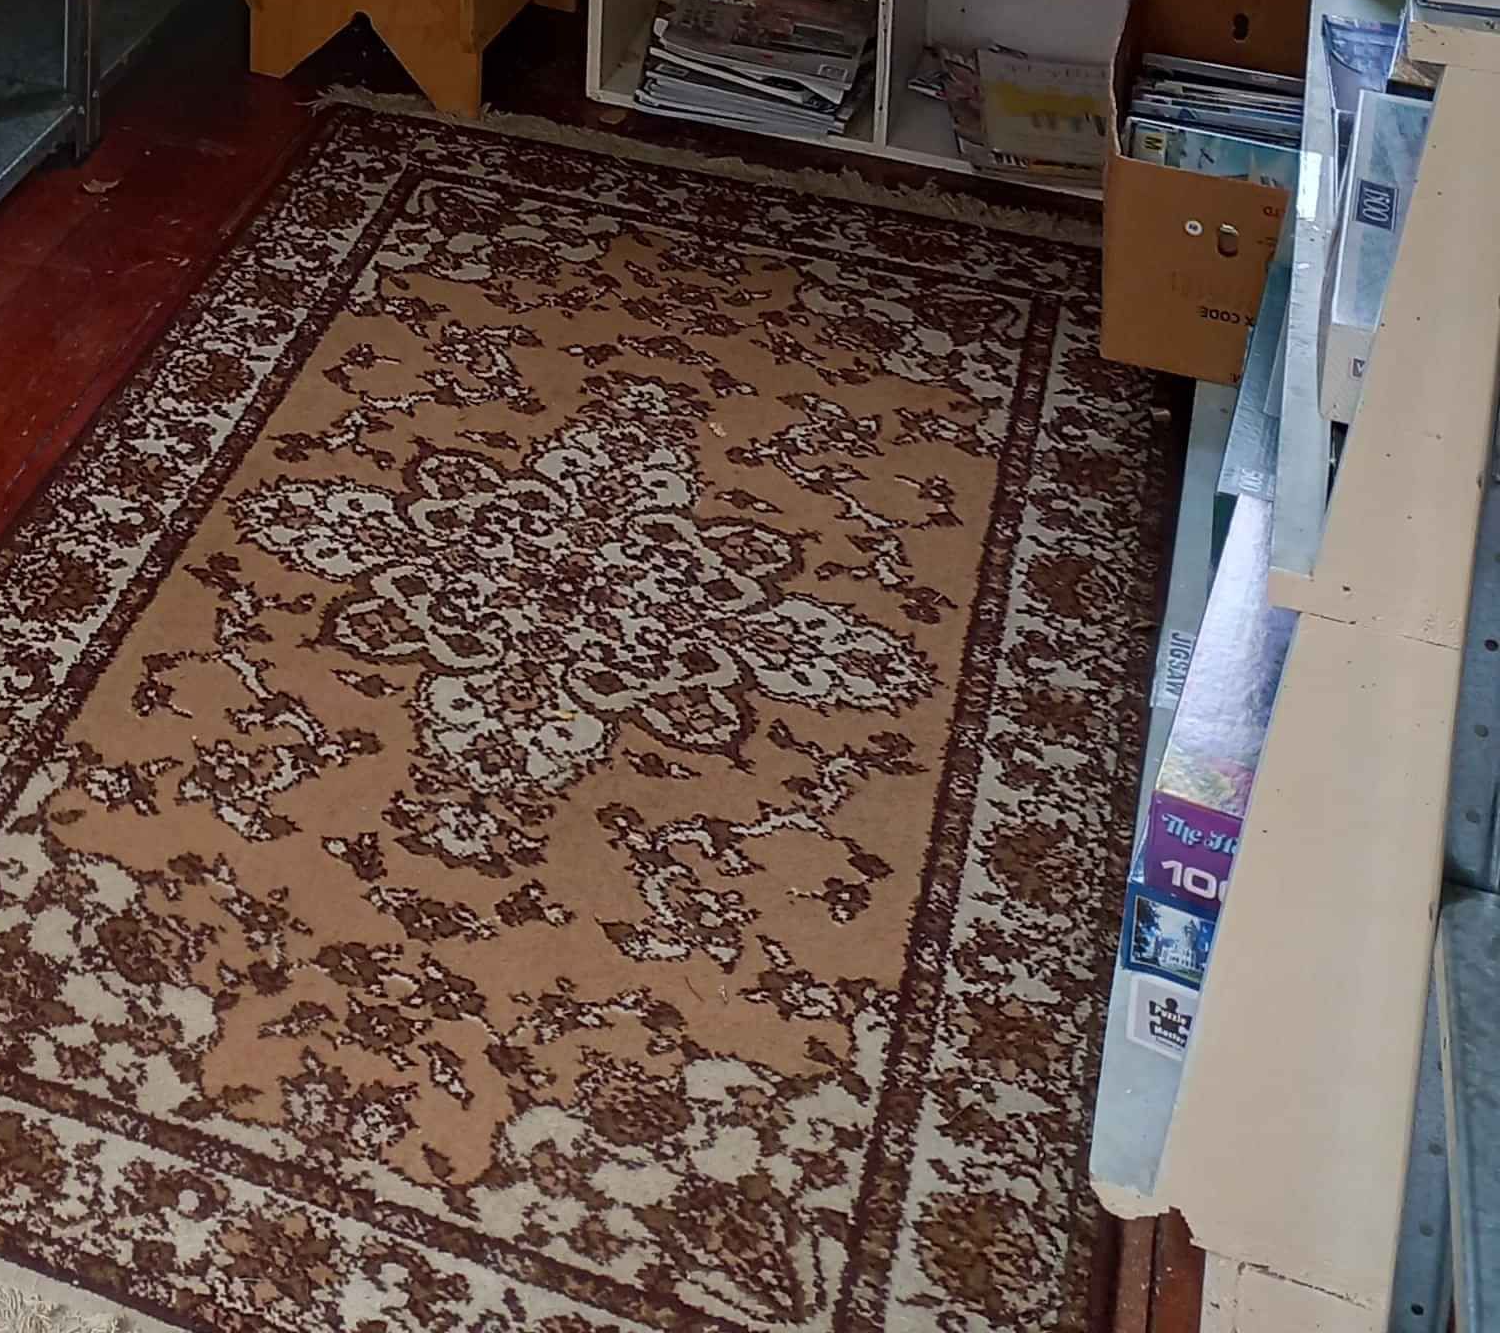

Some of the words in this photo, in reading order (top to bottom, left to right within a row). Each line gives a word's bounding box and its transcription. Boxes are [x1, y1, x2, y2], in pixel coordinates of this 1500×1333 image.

[1197, 306, 1240, 325] CODE
[1166, 633, 1192, 696] JIGSAW
[1162, 813, 1202, 846] The
